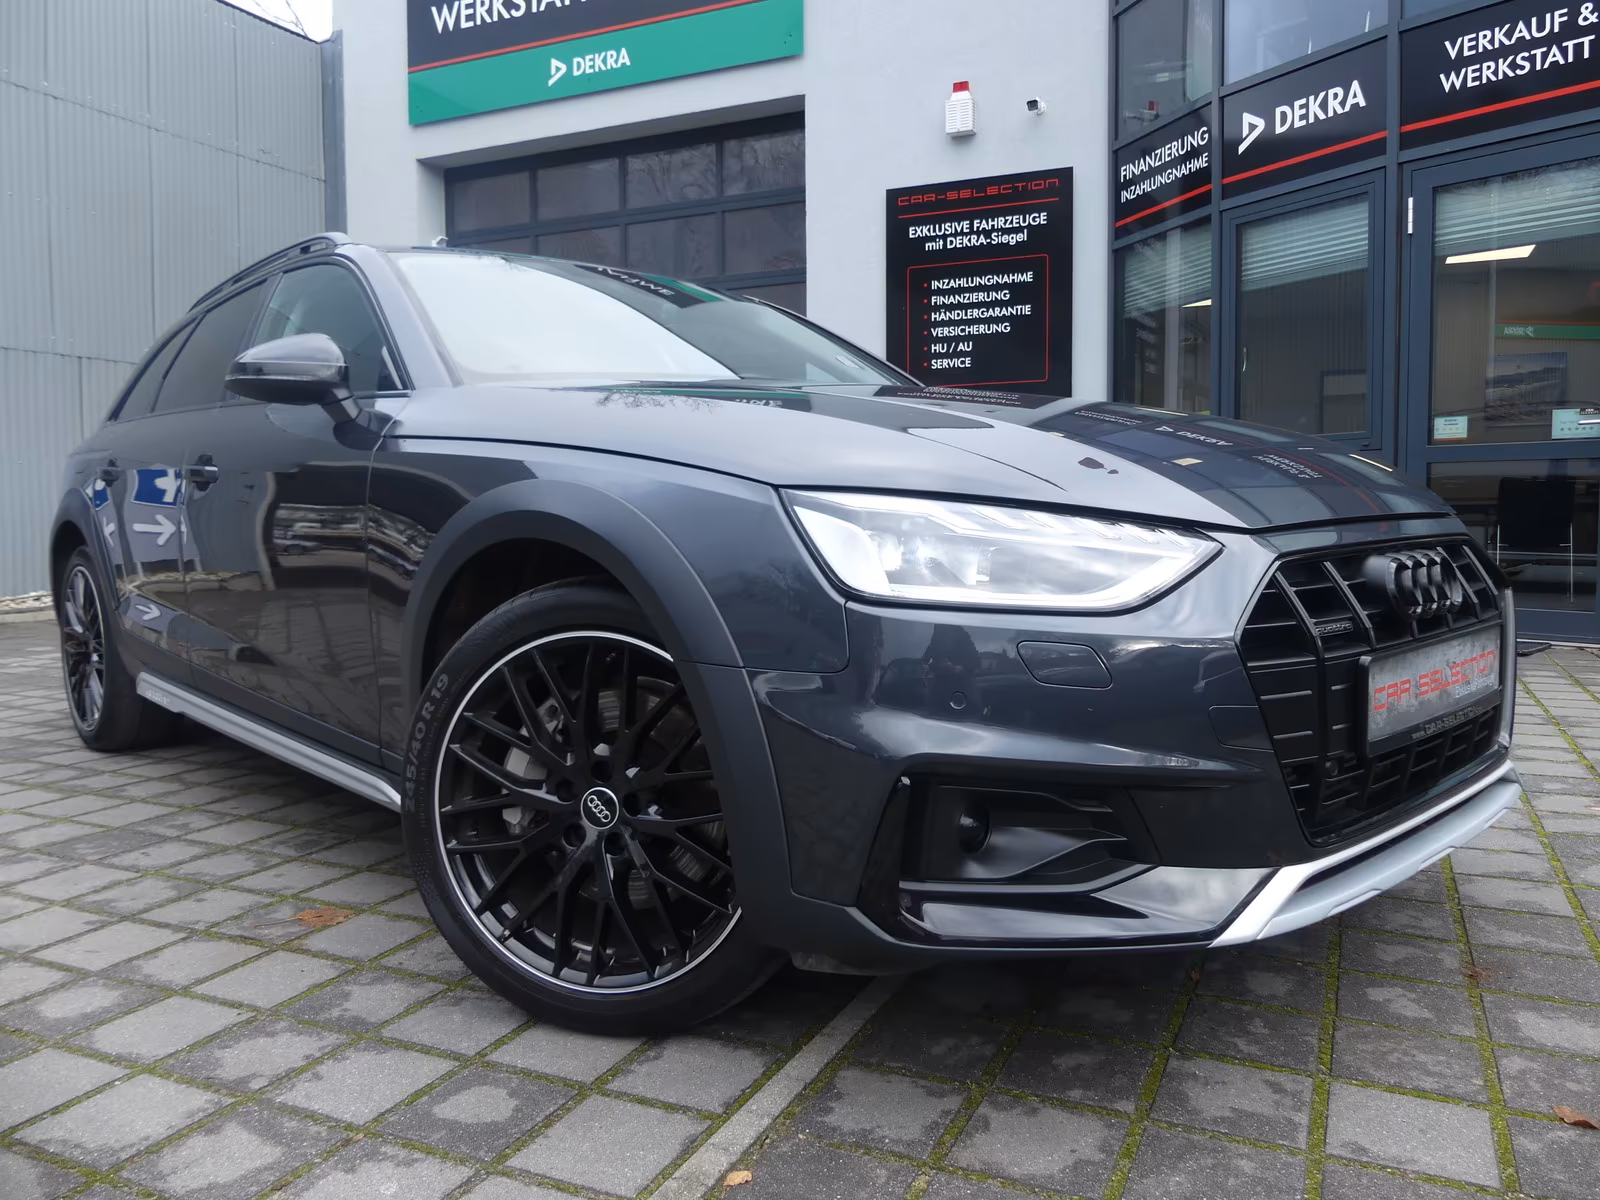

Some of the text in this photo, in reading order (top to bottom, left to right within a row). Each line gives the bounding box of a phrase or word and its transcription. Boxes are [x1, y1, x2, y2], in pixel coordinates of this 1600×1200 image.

[1444, 2, 1600, 60] VERKAUF &
[572, 47, 631, 76] DEKRA
[1439, 34, 1596, 93] WERKSTATT
[1274, 79, 1367, 135] DEKRA
[1120, 126, 1209, 183] FINANZIERUNG
[1120, 152, 1209, 203] INZAHLUNGNAHME
[897, 178, 1060, 206] CAR-SELECTION
[908, 212, 1048, 238] EXKLUSIVE FAHRZEUGE
[925, 229, 1028, 251] mit DEKRA-Siegel
[931, 271, 1034, 290] INZAHLUNGNAHME
[931, 290, 1010, 306] FINANZIERUNG
[931, 304, 1032, 322] HÄNDLERGARANTIE
[931, 323, 1011, 338] VERSICHERUNG
[931, 343, 947, 353] HU
[957, 341, 973, 352] AU
[931, 357, 971, 369] SERVICE
